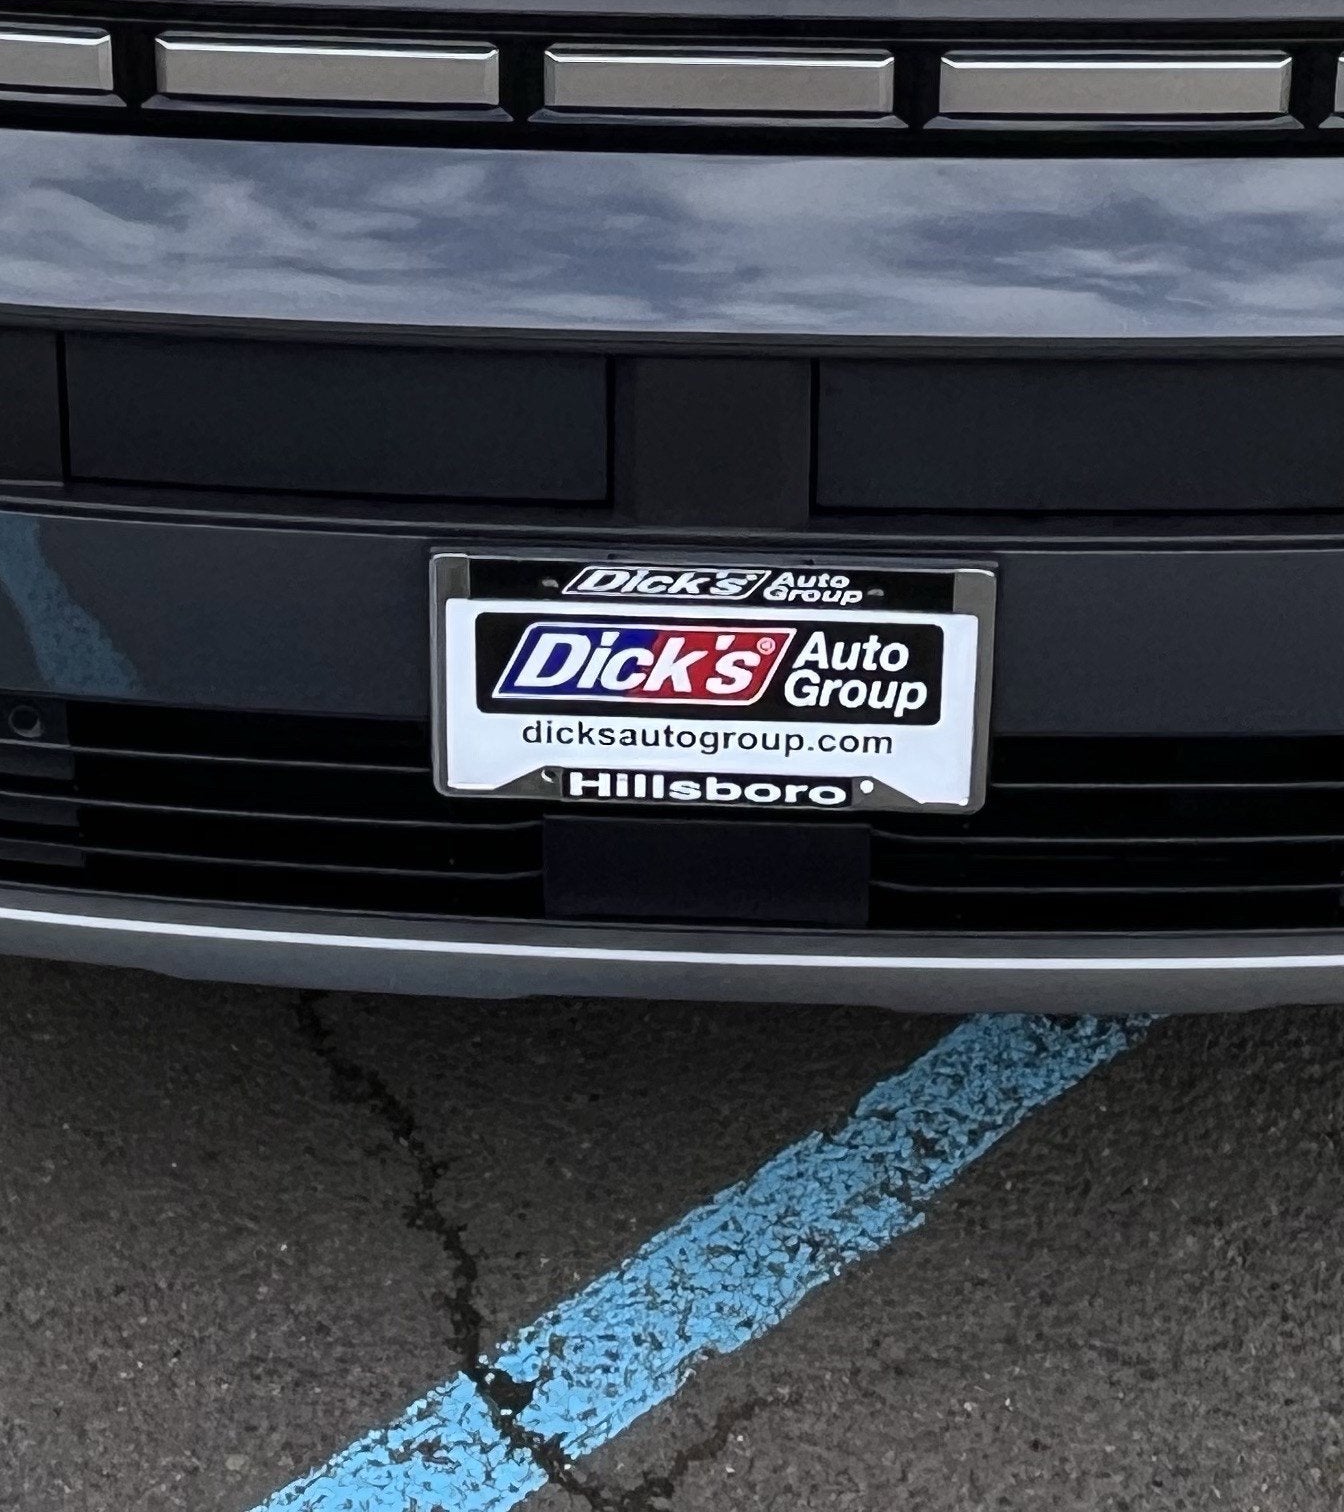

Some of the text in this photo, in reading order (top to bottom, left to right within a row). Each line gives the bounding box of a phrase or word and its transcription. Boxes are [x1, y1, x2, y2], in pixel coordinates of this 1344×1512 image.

[763, 587, 863, 606] Group
[769, 571, 851, 589] Auto
[792, 630, 909, 672] Auto
[784, 670, 928, 718] Group
[522, 719, 893, 758] dicksautogroup.com
[568, 771, 847, 806] Hillsboro
